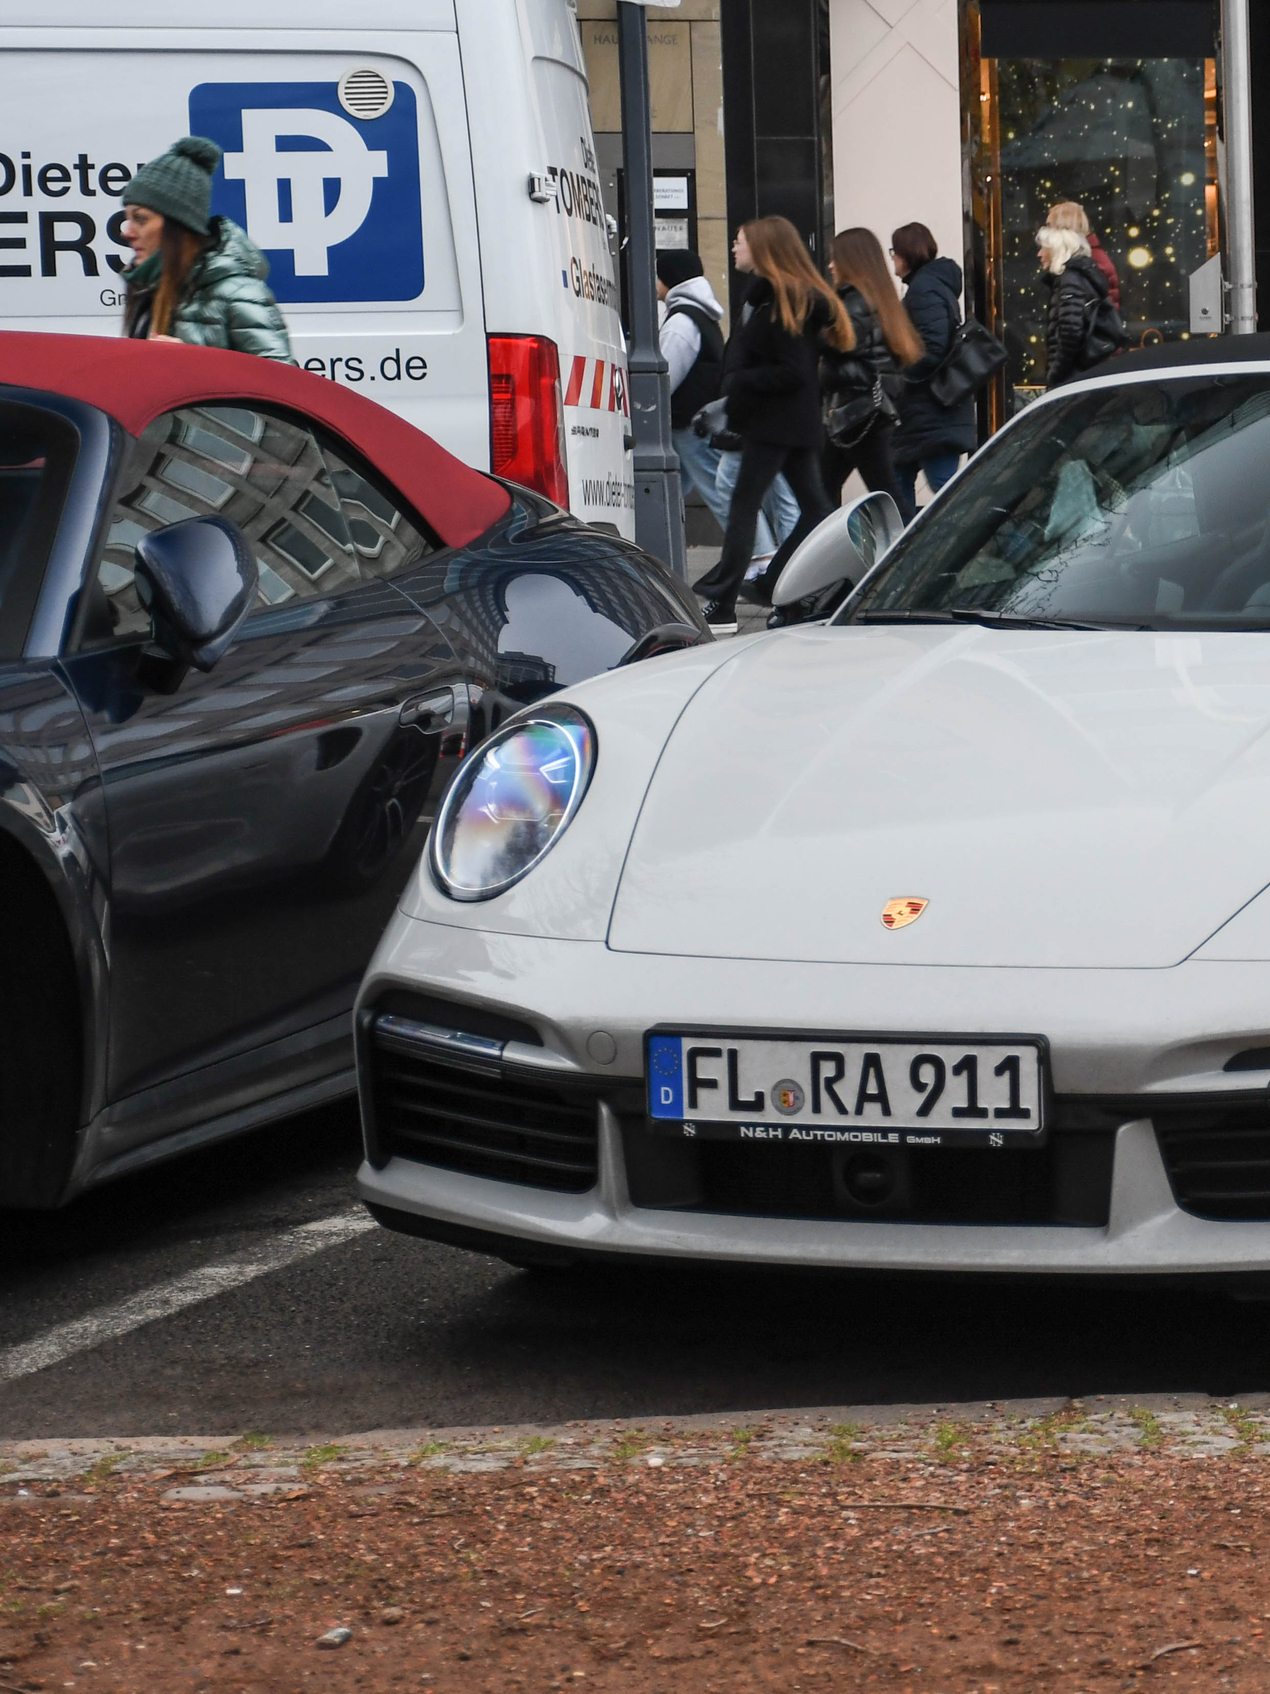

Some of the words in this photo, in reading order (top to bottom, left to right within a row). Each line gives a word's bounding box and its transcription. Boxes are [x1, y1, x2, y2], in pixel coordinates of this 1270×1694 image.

[296, 348, 428, 381] ers.de
[660, 1086, 674, 1105] D
[686, 1046, 765, 1112] FL
[810, 1050, 892, 1117] RA
[909, 1053, 1031, 1119] 911
[739, 1126, 783, 1139] N&H
[788, 1128, 900, 1143] AUTOMOBILE
